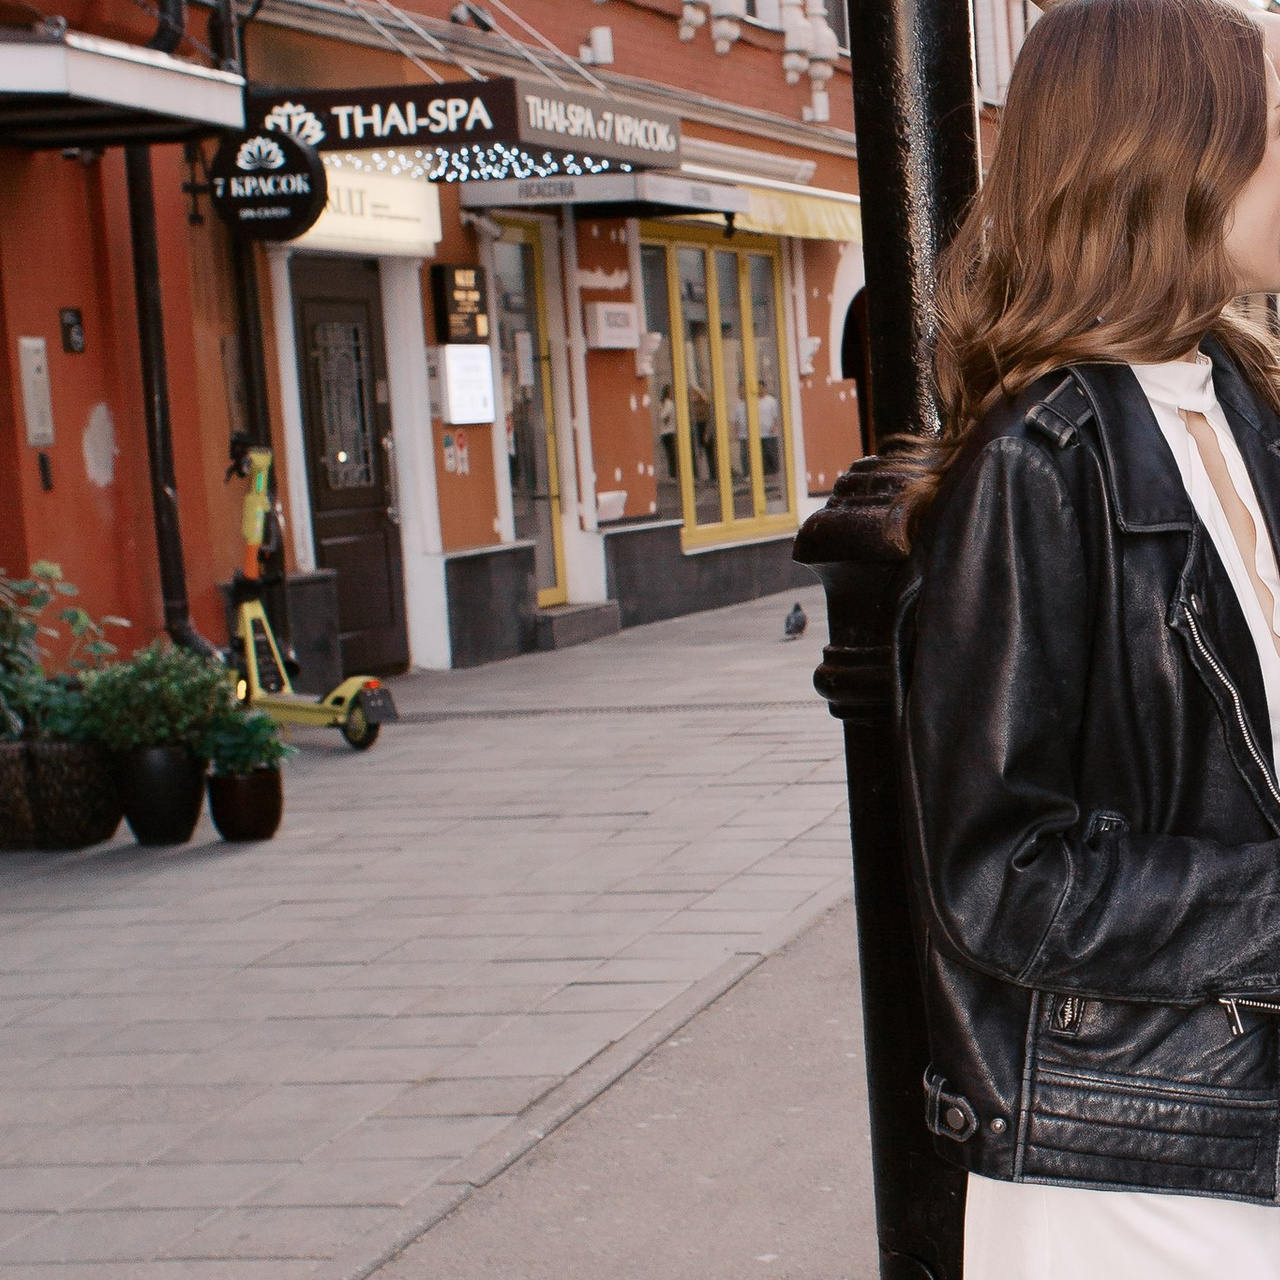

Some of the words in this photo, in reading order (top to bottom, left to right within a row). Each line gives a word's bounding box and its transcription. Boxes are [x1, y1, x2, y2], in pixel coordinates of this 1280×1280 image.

[331, 96, 493, 139] THAI-SPA
[524, 95, 598, 140] THAI-SPA
[212, 177, 226, 199] 7
[230, 173, 312, 199] КРАСОК
